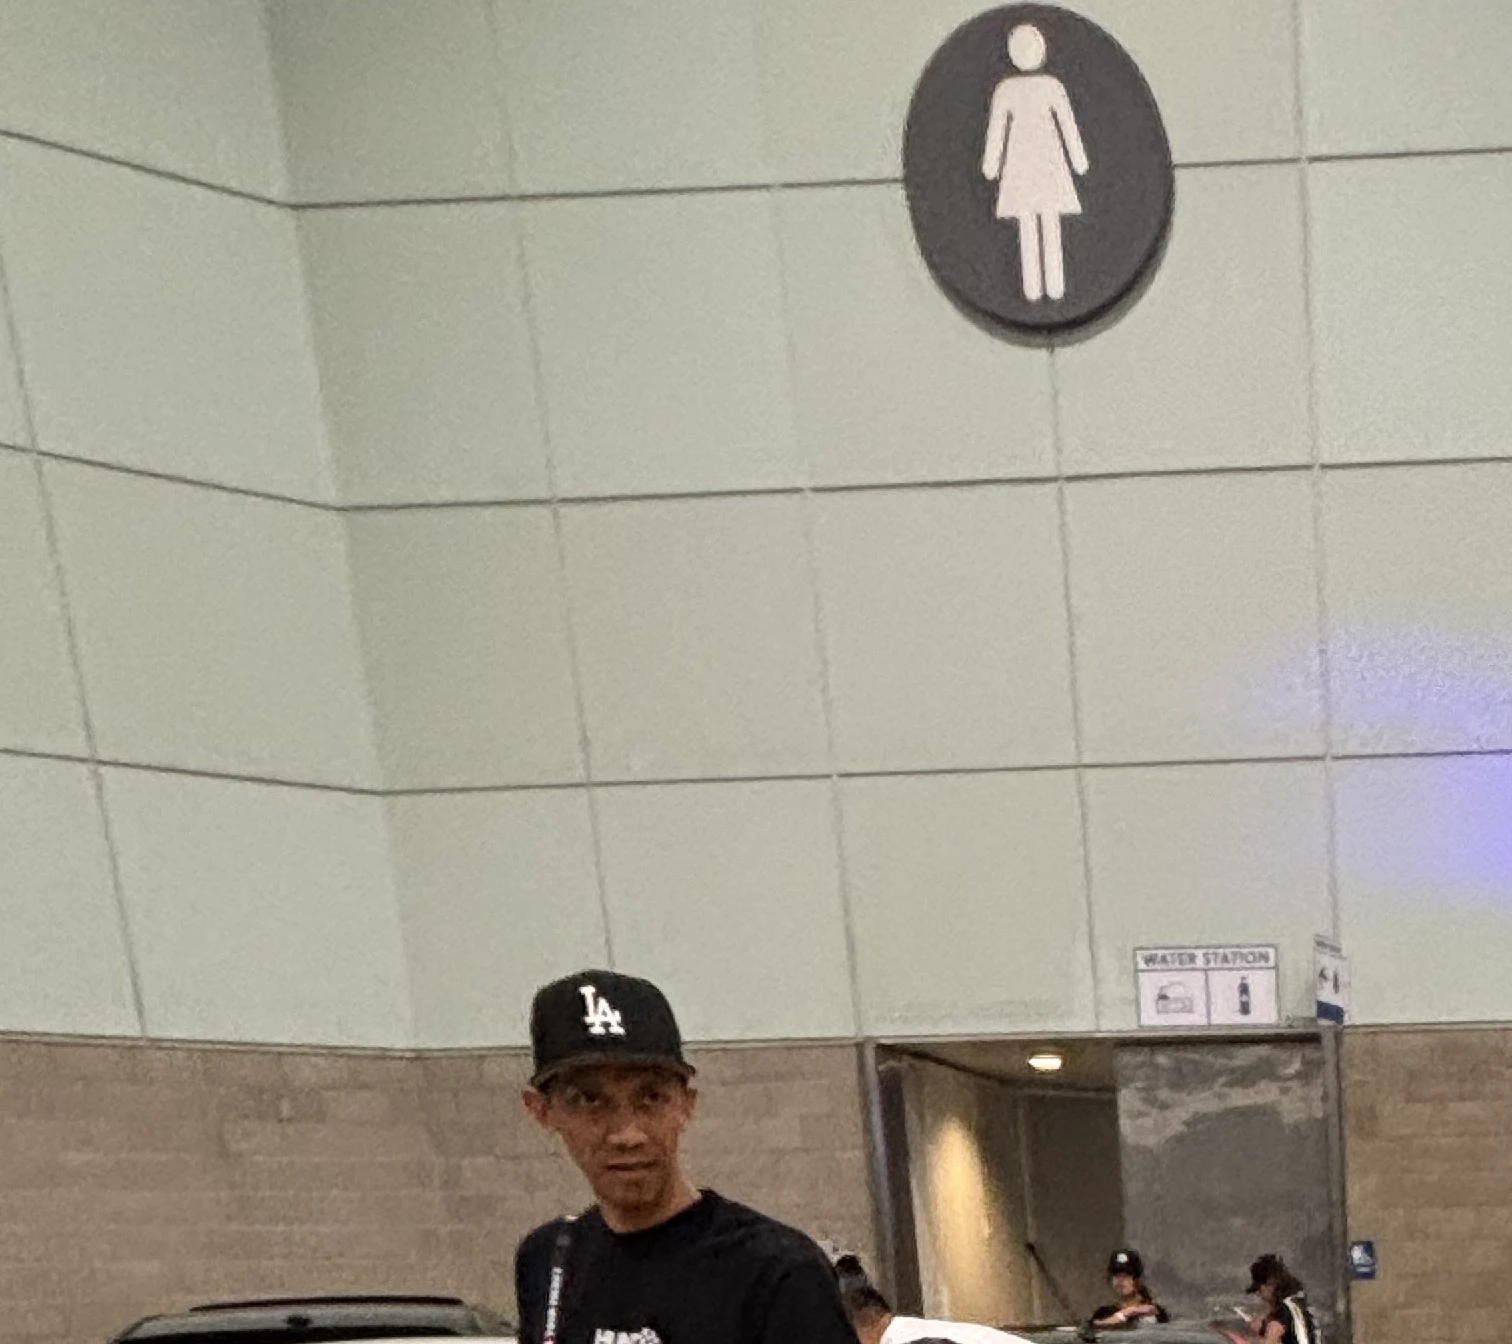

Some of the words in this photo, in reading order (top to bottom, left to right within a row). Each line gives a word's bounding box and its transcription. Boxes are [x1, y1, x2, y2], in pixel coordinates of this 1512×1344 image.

[1143, 952, 1197, 968] WATER
[1202, 950, 1270, 966] STATION
[579, 985, 627, 1035] LA
